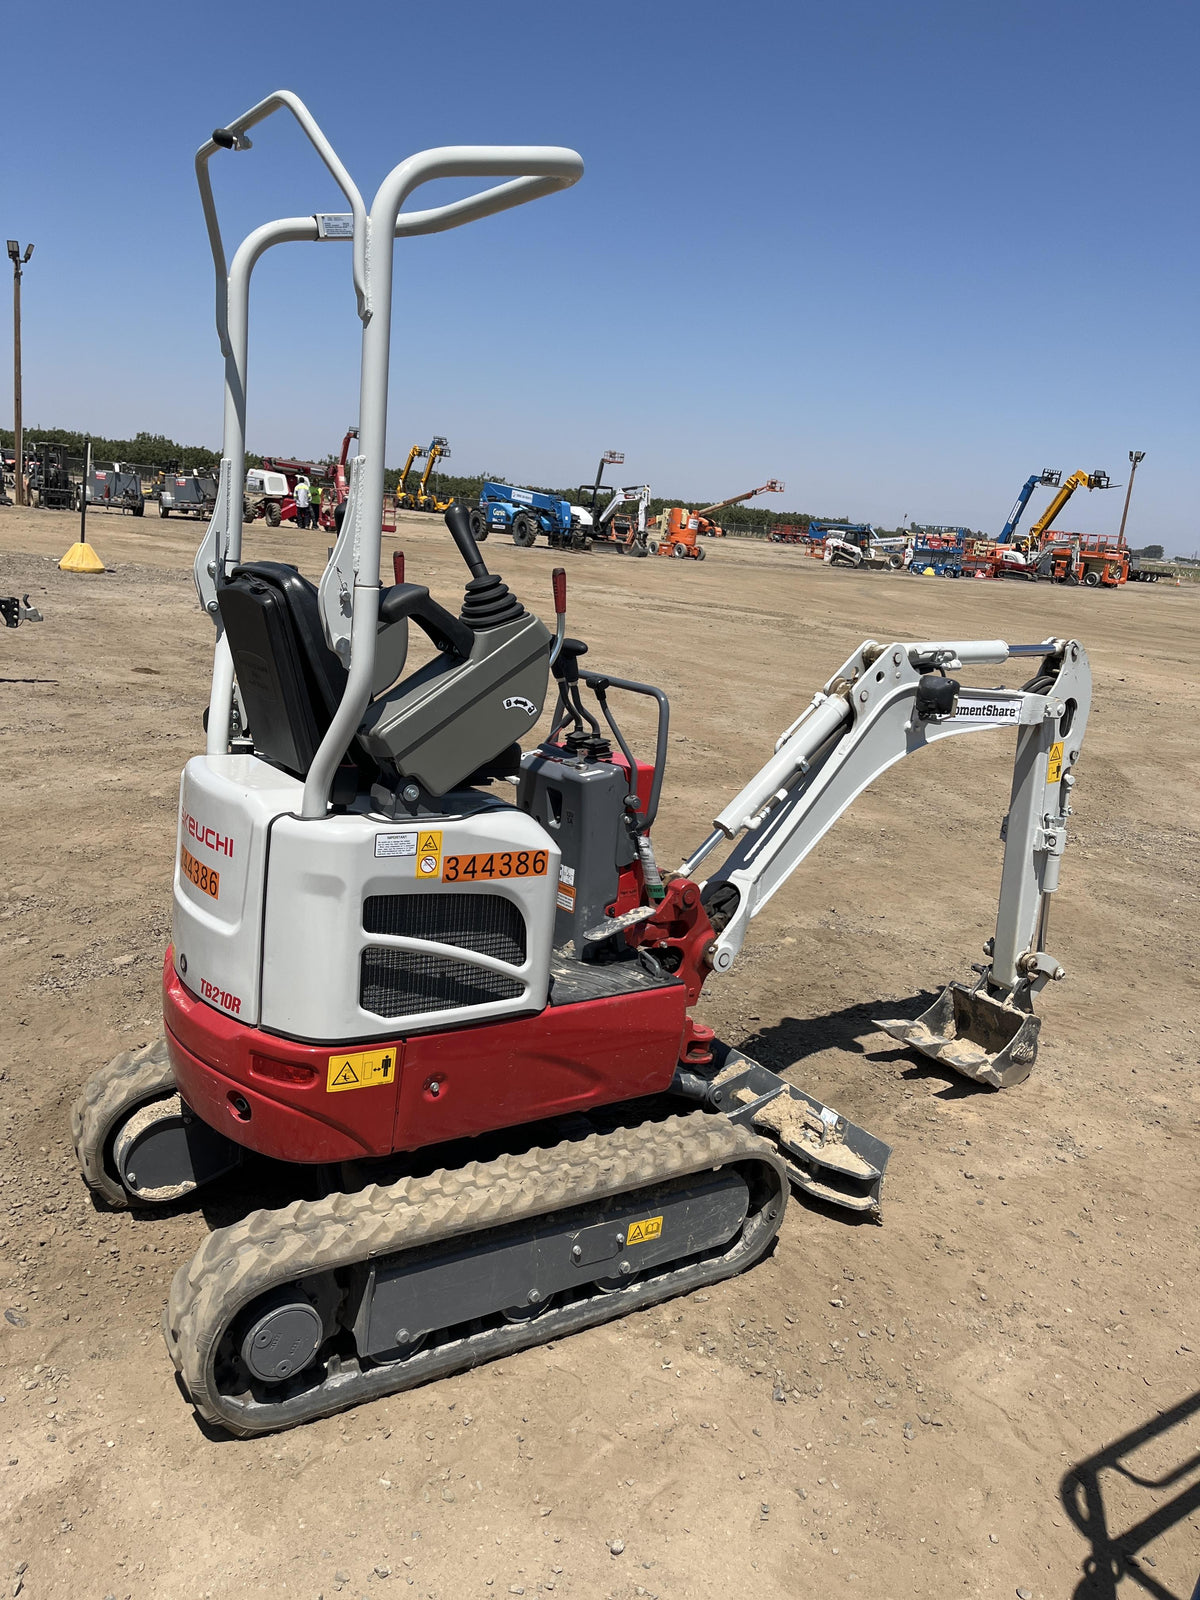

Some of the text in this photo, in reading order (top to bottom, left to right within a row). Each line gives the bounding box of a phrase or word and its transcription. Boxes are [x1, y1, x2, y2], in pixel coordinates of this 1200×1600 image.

[181, 851, 218, 896] 44386
[445, 851, 546, 881] 344386
[201, 977, 242, 1014] TB210R
